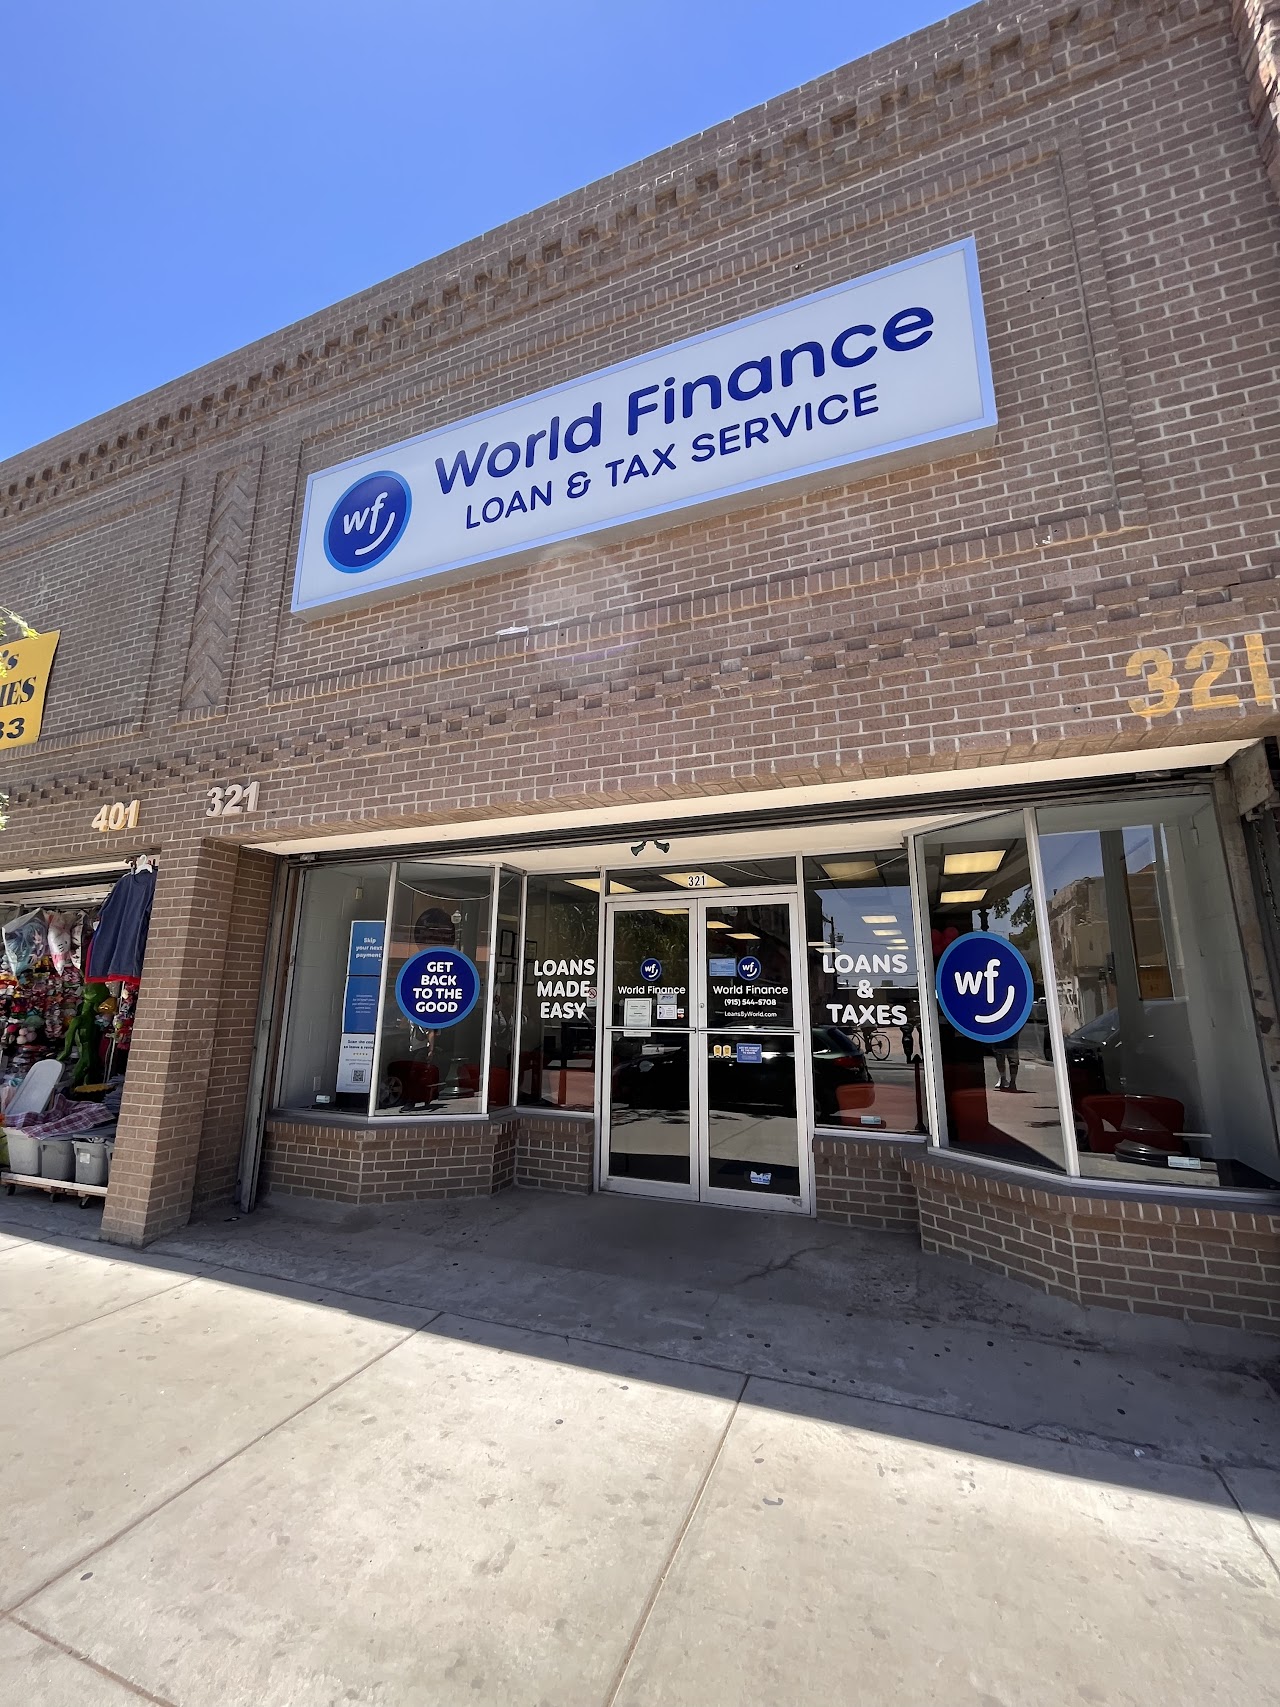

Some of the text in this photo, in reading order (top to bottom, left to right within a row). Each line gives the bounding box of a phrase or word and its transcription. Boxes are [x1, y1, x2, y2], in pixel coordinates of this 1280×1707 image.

[434, 306, 934, 495] World Finance
[466, 383, 879, 529] LOAN & TAX SERVICE
[343, 491, 388, 535] wf
[1126, 633, 1273, 718] 321
[206, 781, 260, 817] 321
[91, 799, 140, 832] 401
[688, 875, 705, 887] 321
[426, 961, 454, 973] GET
[533, 958, 595, 976] LOANS
[644, 963, 657, 974] wf
[742, 961, 755, 973] wf
[822, 953, 909, 974] LOANS
[420, 974, 457, 986] BACK
[536, 980, 591, 997] MADE
[856, 979, 875, 999] &
[954, 958, 1001, 1004] wf
[412, 987, 463, 999] TO THE
[617, 985, 686, 995] World Finance
[712, 985, 789, 995] World Finance
[415, 1001, 458, 1013] GOOD
[540, 1001, 587, 1019] EASY
[724, 998, 777, 1007] (915) 544-5708
[826, 1003, 908, 1025] TAXES
